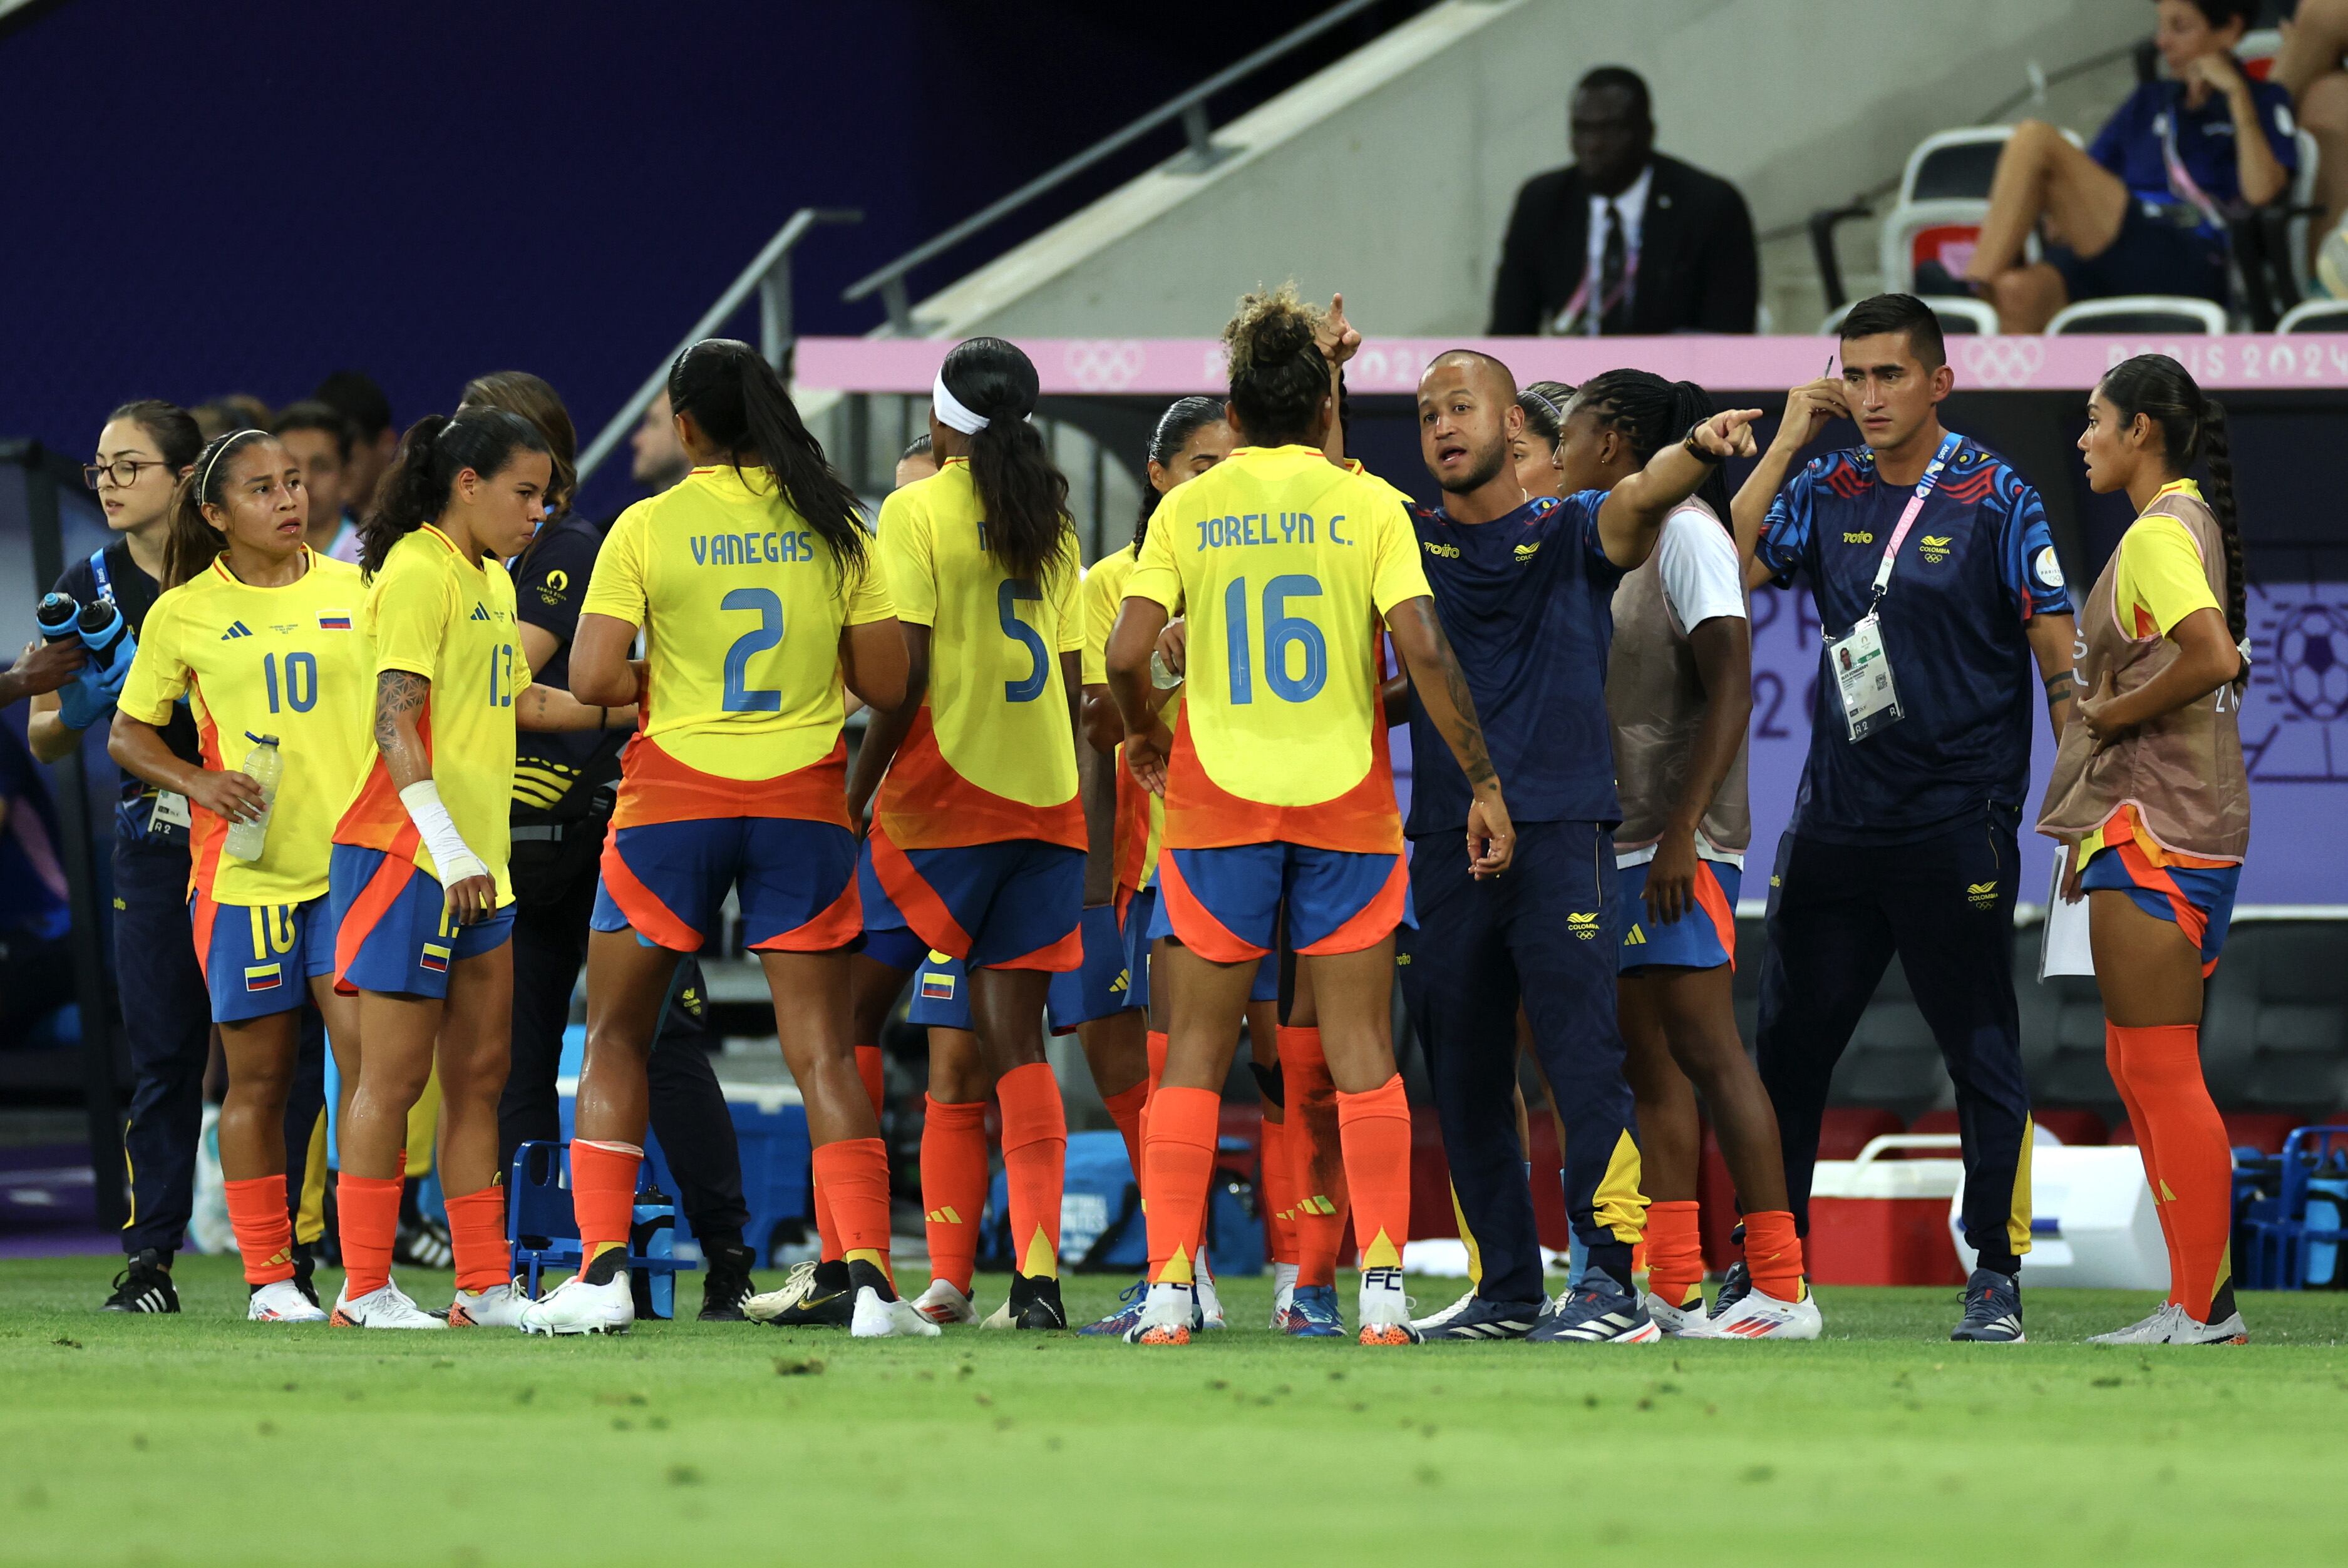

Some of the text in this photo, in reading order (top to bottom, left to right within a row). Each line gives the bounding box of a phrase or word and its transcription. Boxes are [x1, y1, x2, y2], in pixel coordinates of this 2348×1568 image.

[691, 531, 814, 566] VANEGAS
[1197, 513, 1353, 552] JORELYN C.
[1919, 546, 1950, 555] COLOMBIA
[721, 588, 784, 712] 2
[997, 578, 1049, 702] 5
[1225, 575, 1327, 705] 16
[264, 652, 317, 714] 10
[490, 643, 512, 707] 13
[1862, 721, 1868, 731] 2
[163, 824, 172, 834] 2
[1366, 1273, 1401, 1291] FC
